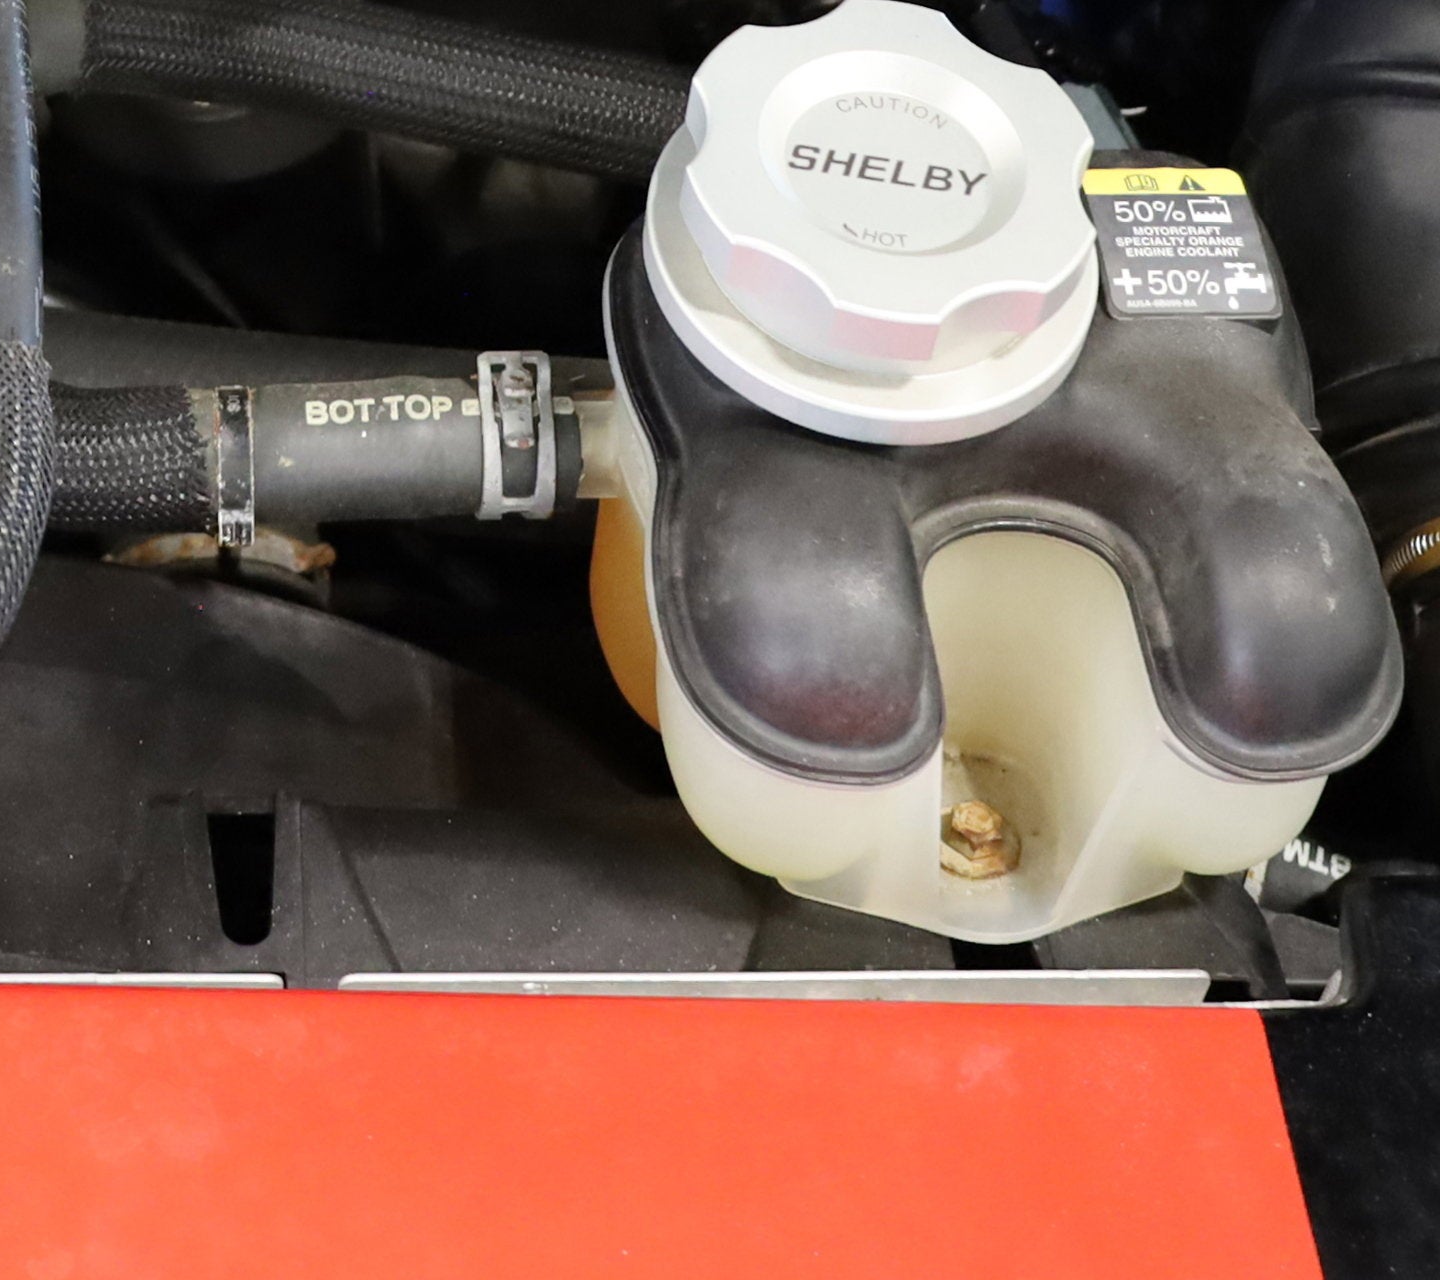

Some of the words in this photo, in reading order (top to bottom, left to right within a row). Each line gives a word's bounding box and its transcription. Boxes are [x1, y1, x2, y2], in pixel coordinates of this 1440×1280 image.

[835, 96, 948, 130] CAUTION
[788, 144, 988, 196] SHELBY
[1113, 200, 1186, 222] 50%
[861, 228, 908, 248] HOT
[1115, 236, 1186, 247] SPECIALTY
[1188, 236, 1245, 247] ORANGE
[1132, 226, 1222, 236] MOTORCRAFT
[1125, 247, 1175, 257] ENGINE
[1177, 247, 1240, 257] COOLANT
[304, 398, 373, 426] BOT
[382, 394, 453, 422] TOP
